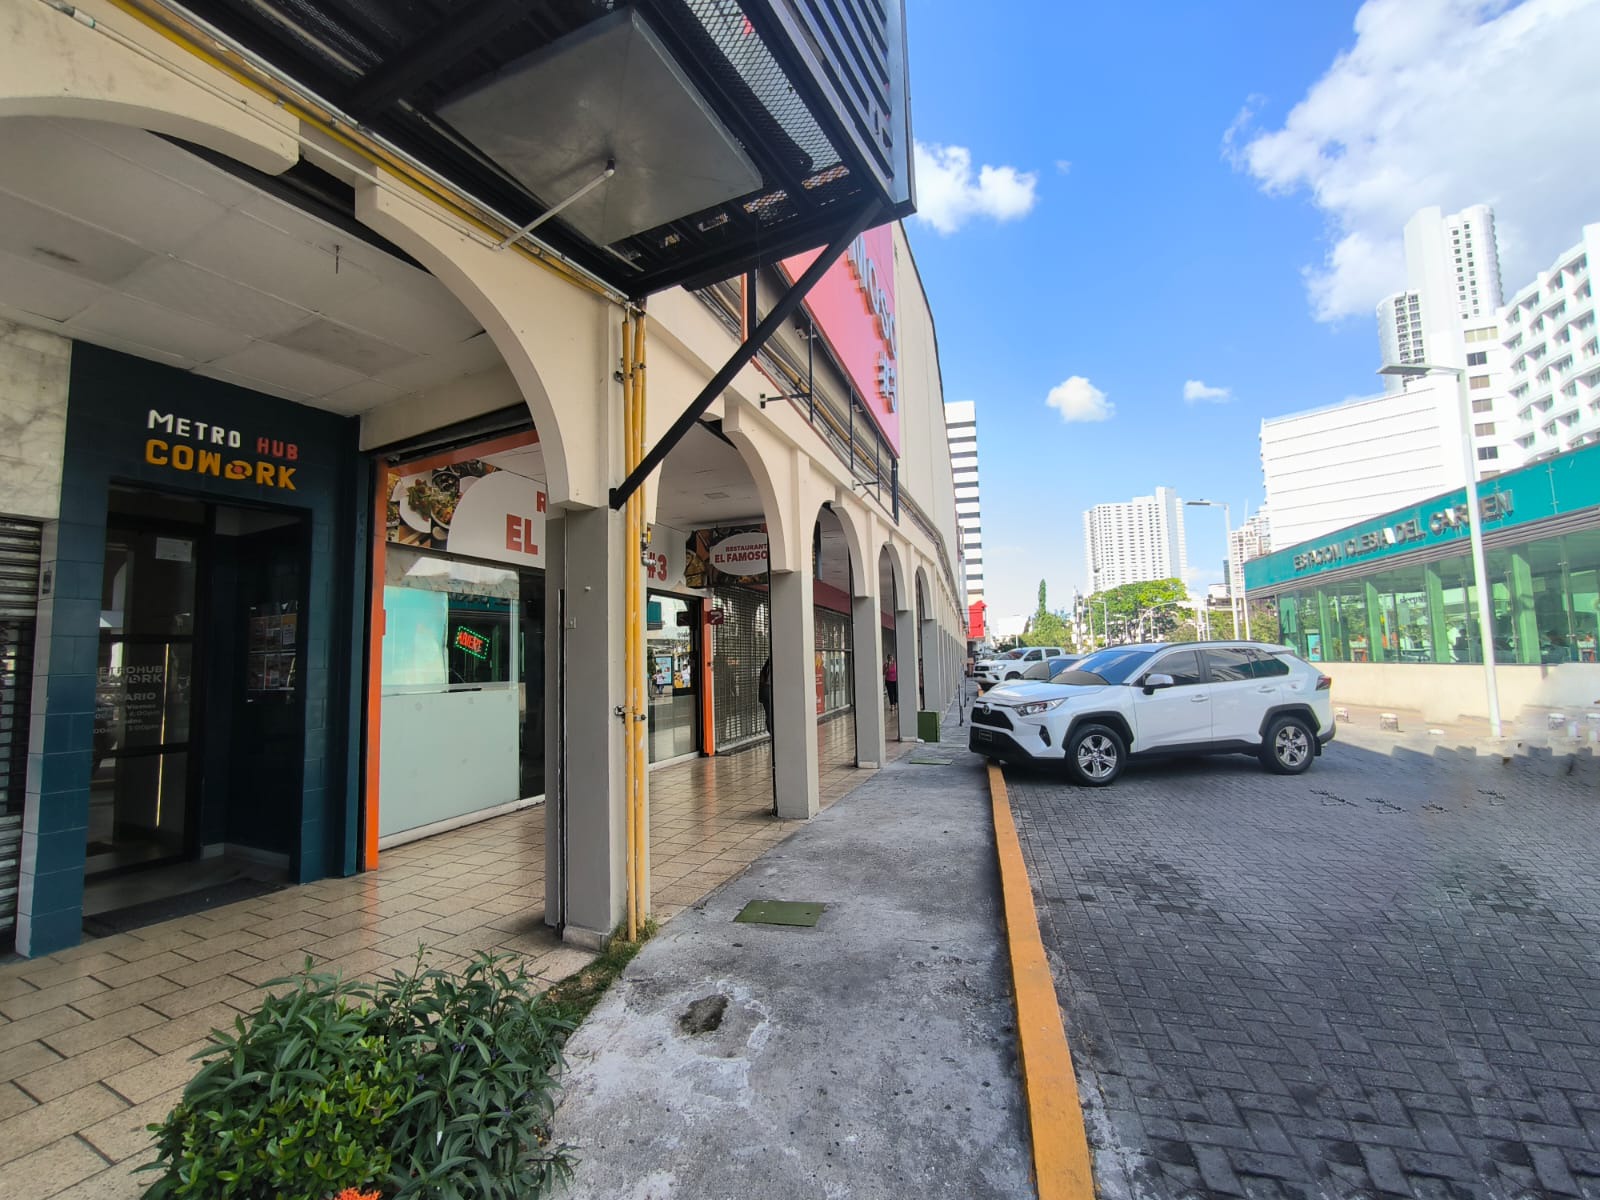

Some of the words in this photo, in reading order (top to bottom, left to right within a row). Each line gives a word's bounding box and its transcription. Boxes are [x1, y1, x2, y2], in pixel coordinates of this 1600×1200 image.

[147, 409, 241, 448] METRO
[256, 437, 299, 460] HUB
[145, 439, 297, 491] COWORK
[506, 513, 538, 555] EL
[1395, 518, 1427, 544] DEL
[1430, 489, 1514, 537] CAREN
[714, 554, 725, 564] EL
[726, 550, 768, 563] FAMOSO
